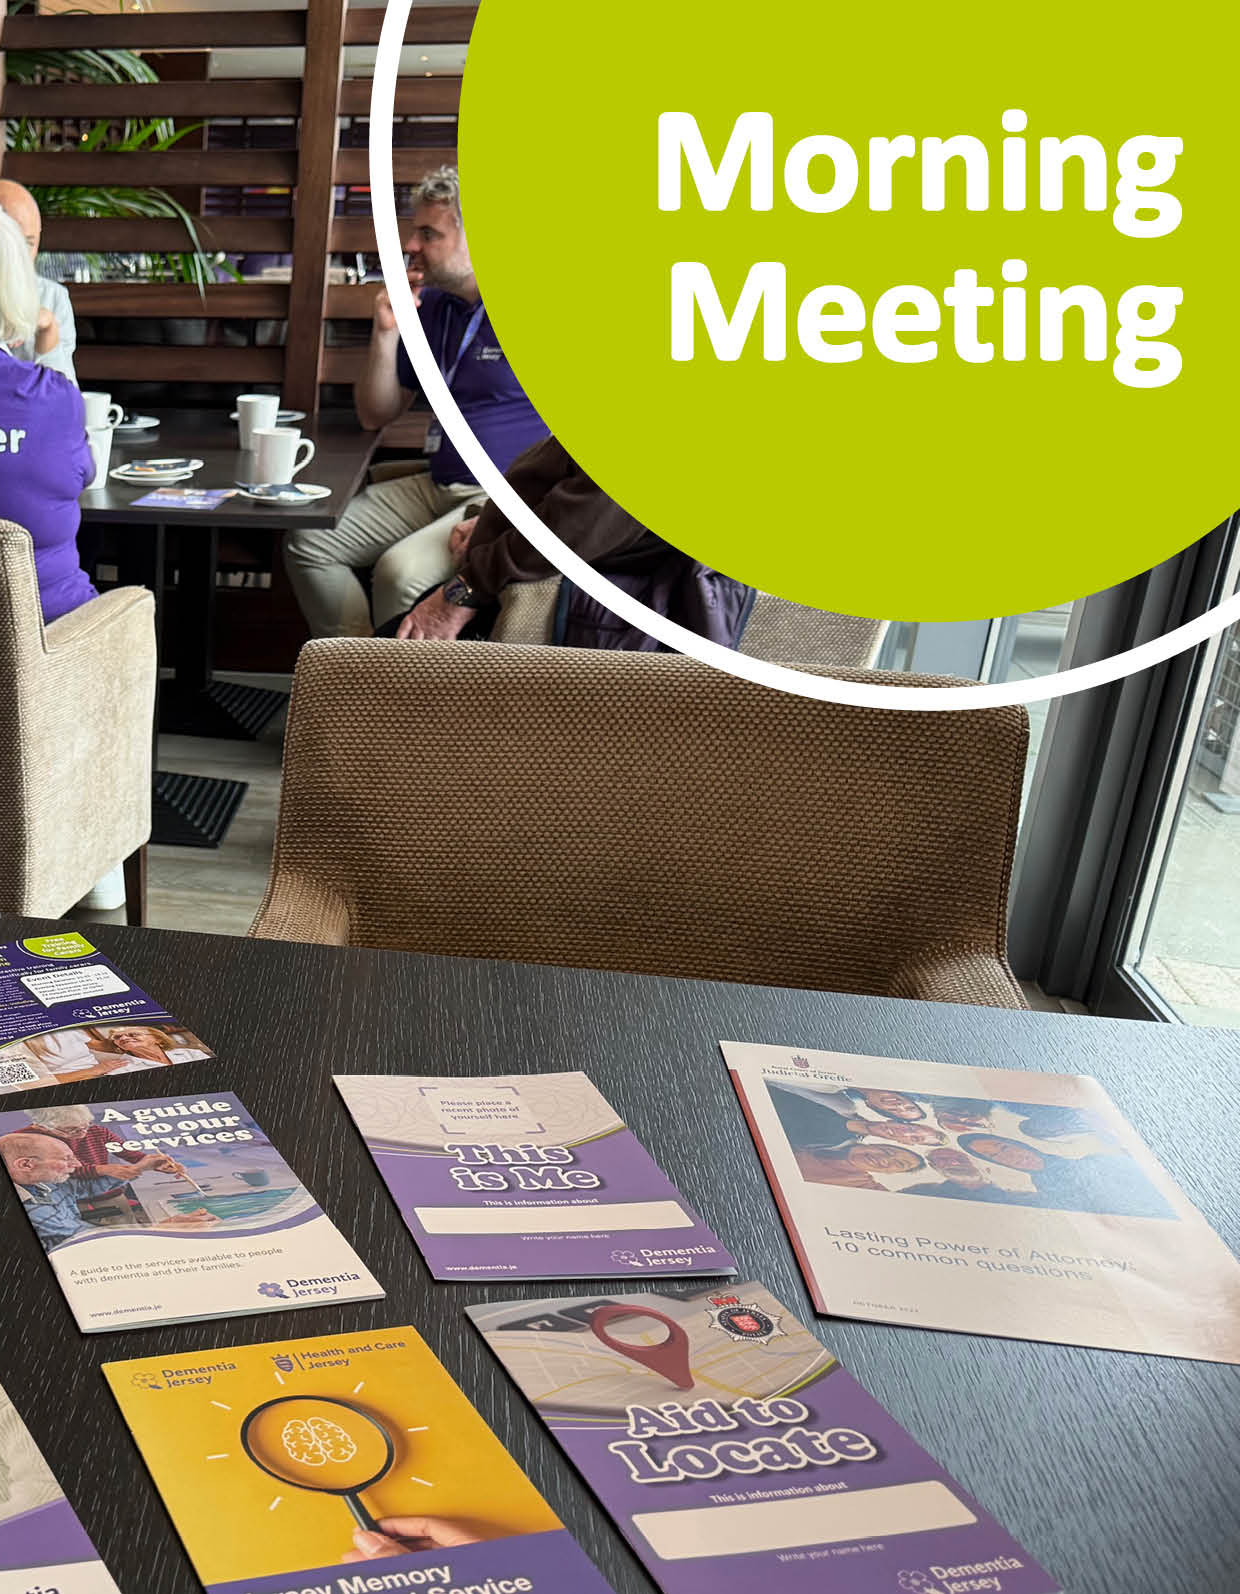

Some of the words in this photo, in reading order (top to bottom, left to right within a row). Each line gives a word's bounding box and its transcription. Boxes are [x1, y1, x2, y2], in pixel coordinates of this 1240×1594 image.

[93, 999, 147, 1012] Dementia
[98, 1006, 131, 1018] Jersey
[761, 1067, 810, 1078] Judicial
[101, 1109, 131, 1123] A
[132, 1100, 233, 1123] guide
[440, 1099, 473, 1107] Please
[475, 1099, 503, 1108] place
[475, 1106, 507, 1114] photo
[132, 1121, 173, 1135] to
[177, 1115, 240, 1133] our
[450, 1113, 493, 1121] yourself
[105, 1129, 254, 1153] services
[445, 1143, 574, 1165] This
[450, 1167, 509, 1190] is
[509, 1166, 600, 1190] Me
[482, 1199, 503, 1207] This
[514, 1198, 570, 1207] information
[571, 1197, 600, 1205] about
[639, 1245, 717, 1258] Dementia
[824, 1226, 909, 1248] Lasting
[915, 1237, 990, 1255] Power
[998, 1247, 1021, 1258] of
[80, 1266, 109, 1277] guide
[125, 1262, 143, 1271] the
[145, 1258, 186, 1268] services
[189, 1253, 233, 1264] available
[234, 1252, 247, 1260] to
[248, 1248, 284, 1259] people
[645, 1256, 693, 1267] Jersey
[832, 1240, 859, 1253] 10
[867, 1247, 969, 1266] common
[976, 1259, 1093, 1280] questions
[74, 1277, 98, 1286] with
[100, 1272, 150, 1282] dementia
[152, 1268, 172, 1277] and
[174, 1265, 199, 1275] their
[286, 1271, 361, 1288] Dementia
[292, 1285, 338, 1299] Jersey
[301, 1347, 345, 1361] Health
[348, 1343, 373, 1355] and
[374, 1340, 407, 1352] Care
[161, 1360, 237, 1379] Dementia
[307, 1357, 351, 1370] Jersey
[166, 1374, 213, 1388] Jersey
[626, 1398, 739, 1438] Aid
[732, 1397, 809, 1426] to
[608, 1427, 878, 1483] Locate
[709, 1493, 733, 1505] This
[734, 1491, 746, 1502] is
[746, 1485, 813, 1501] information
[813, 1480, 848, 1494] about
[776, 1552, 806, 1563] Write
[808, 1550, 830, 1562] your
[831, 1546, 860, 1558] name
[861, 1542, 885, 1553] here
[929, 1555, 1024, 1581] Dementia
[336, 1565, 452, 1594] Memory
[941, 1575, 1003, 1594] Jersey
